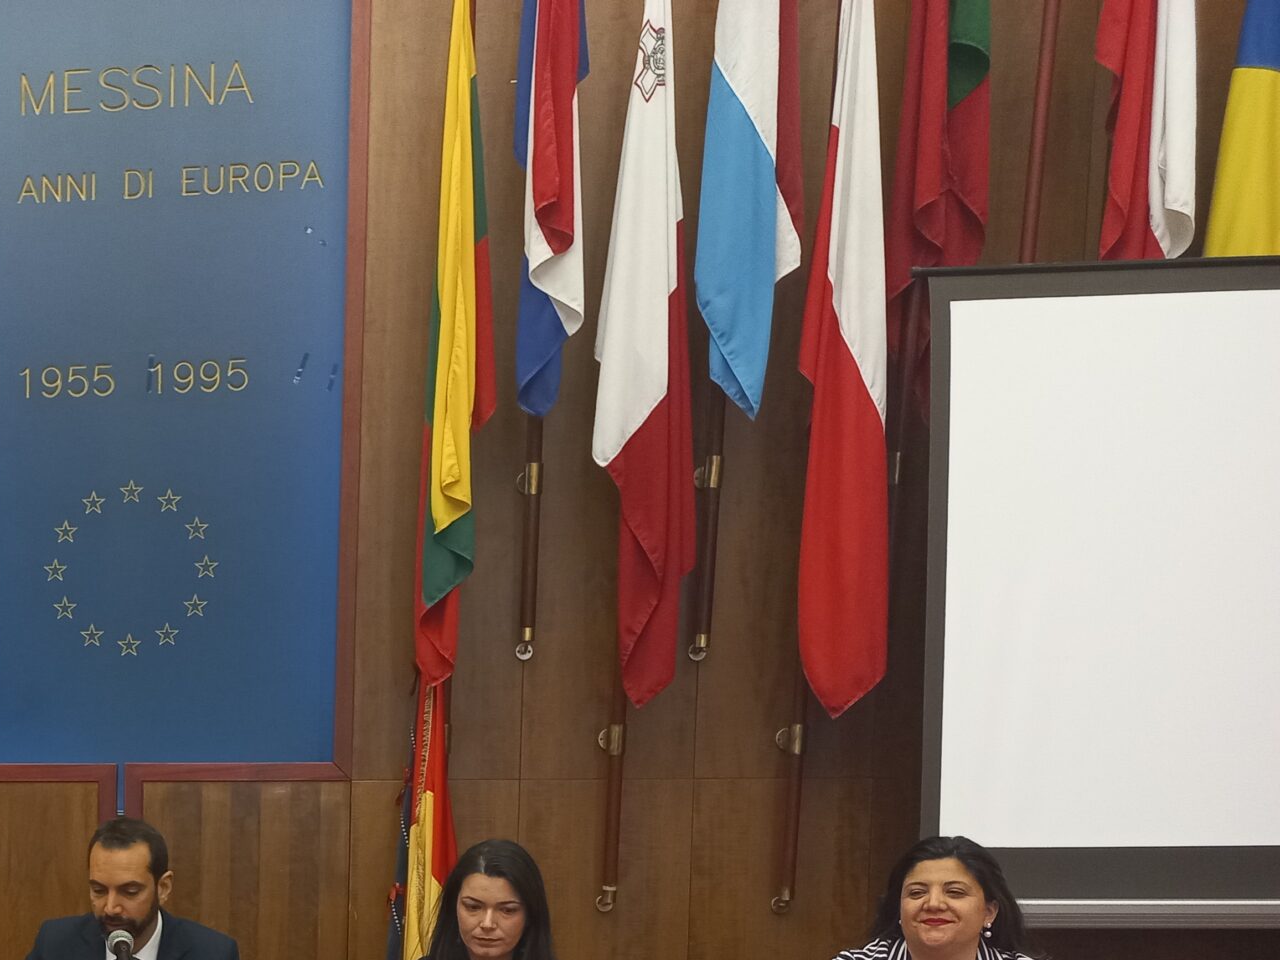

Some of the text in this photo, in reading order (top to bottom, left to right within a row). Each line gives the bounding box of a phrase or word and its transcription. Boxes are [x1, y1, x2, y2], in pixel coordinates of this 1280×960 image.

[19, 60, 255, 116] MESSINA
[17, 172, 97, 205] ANNI
[123, 169, 154, 200] DI
[180, 160, 324, 197] EUROPA
[19, 358, 250, 399] 1955 1995
